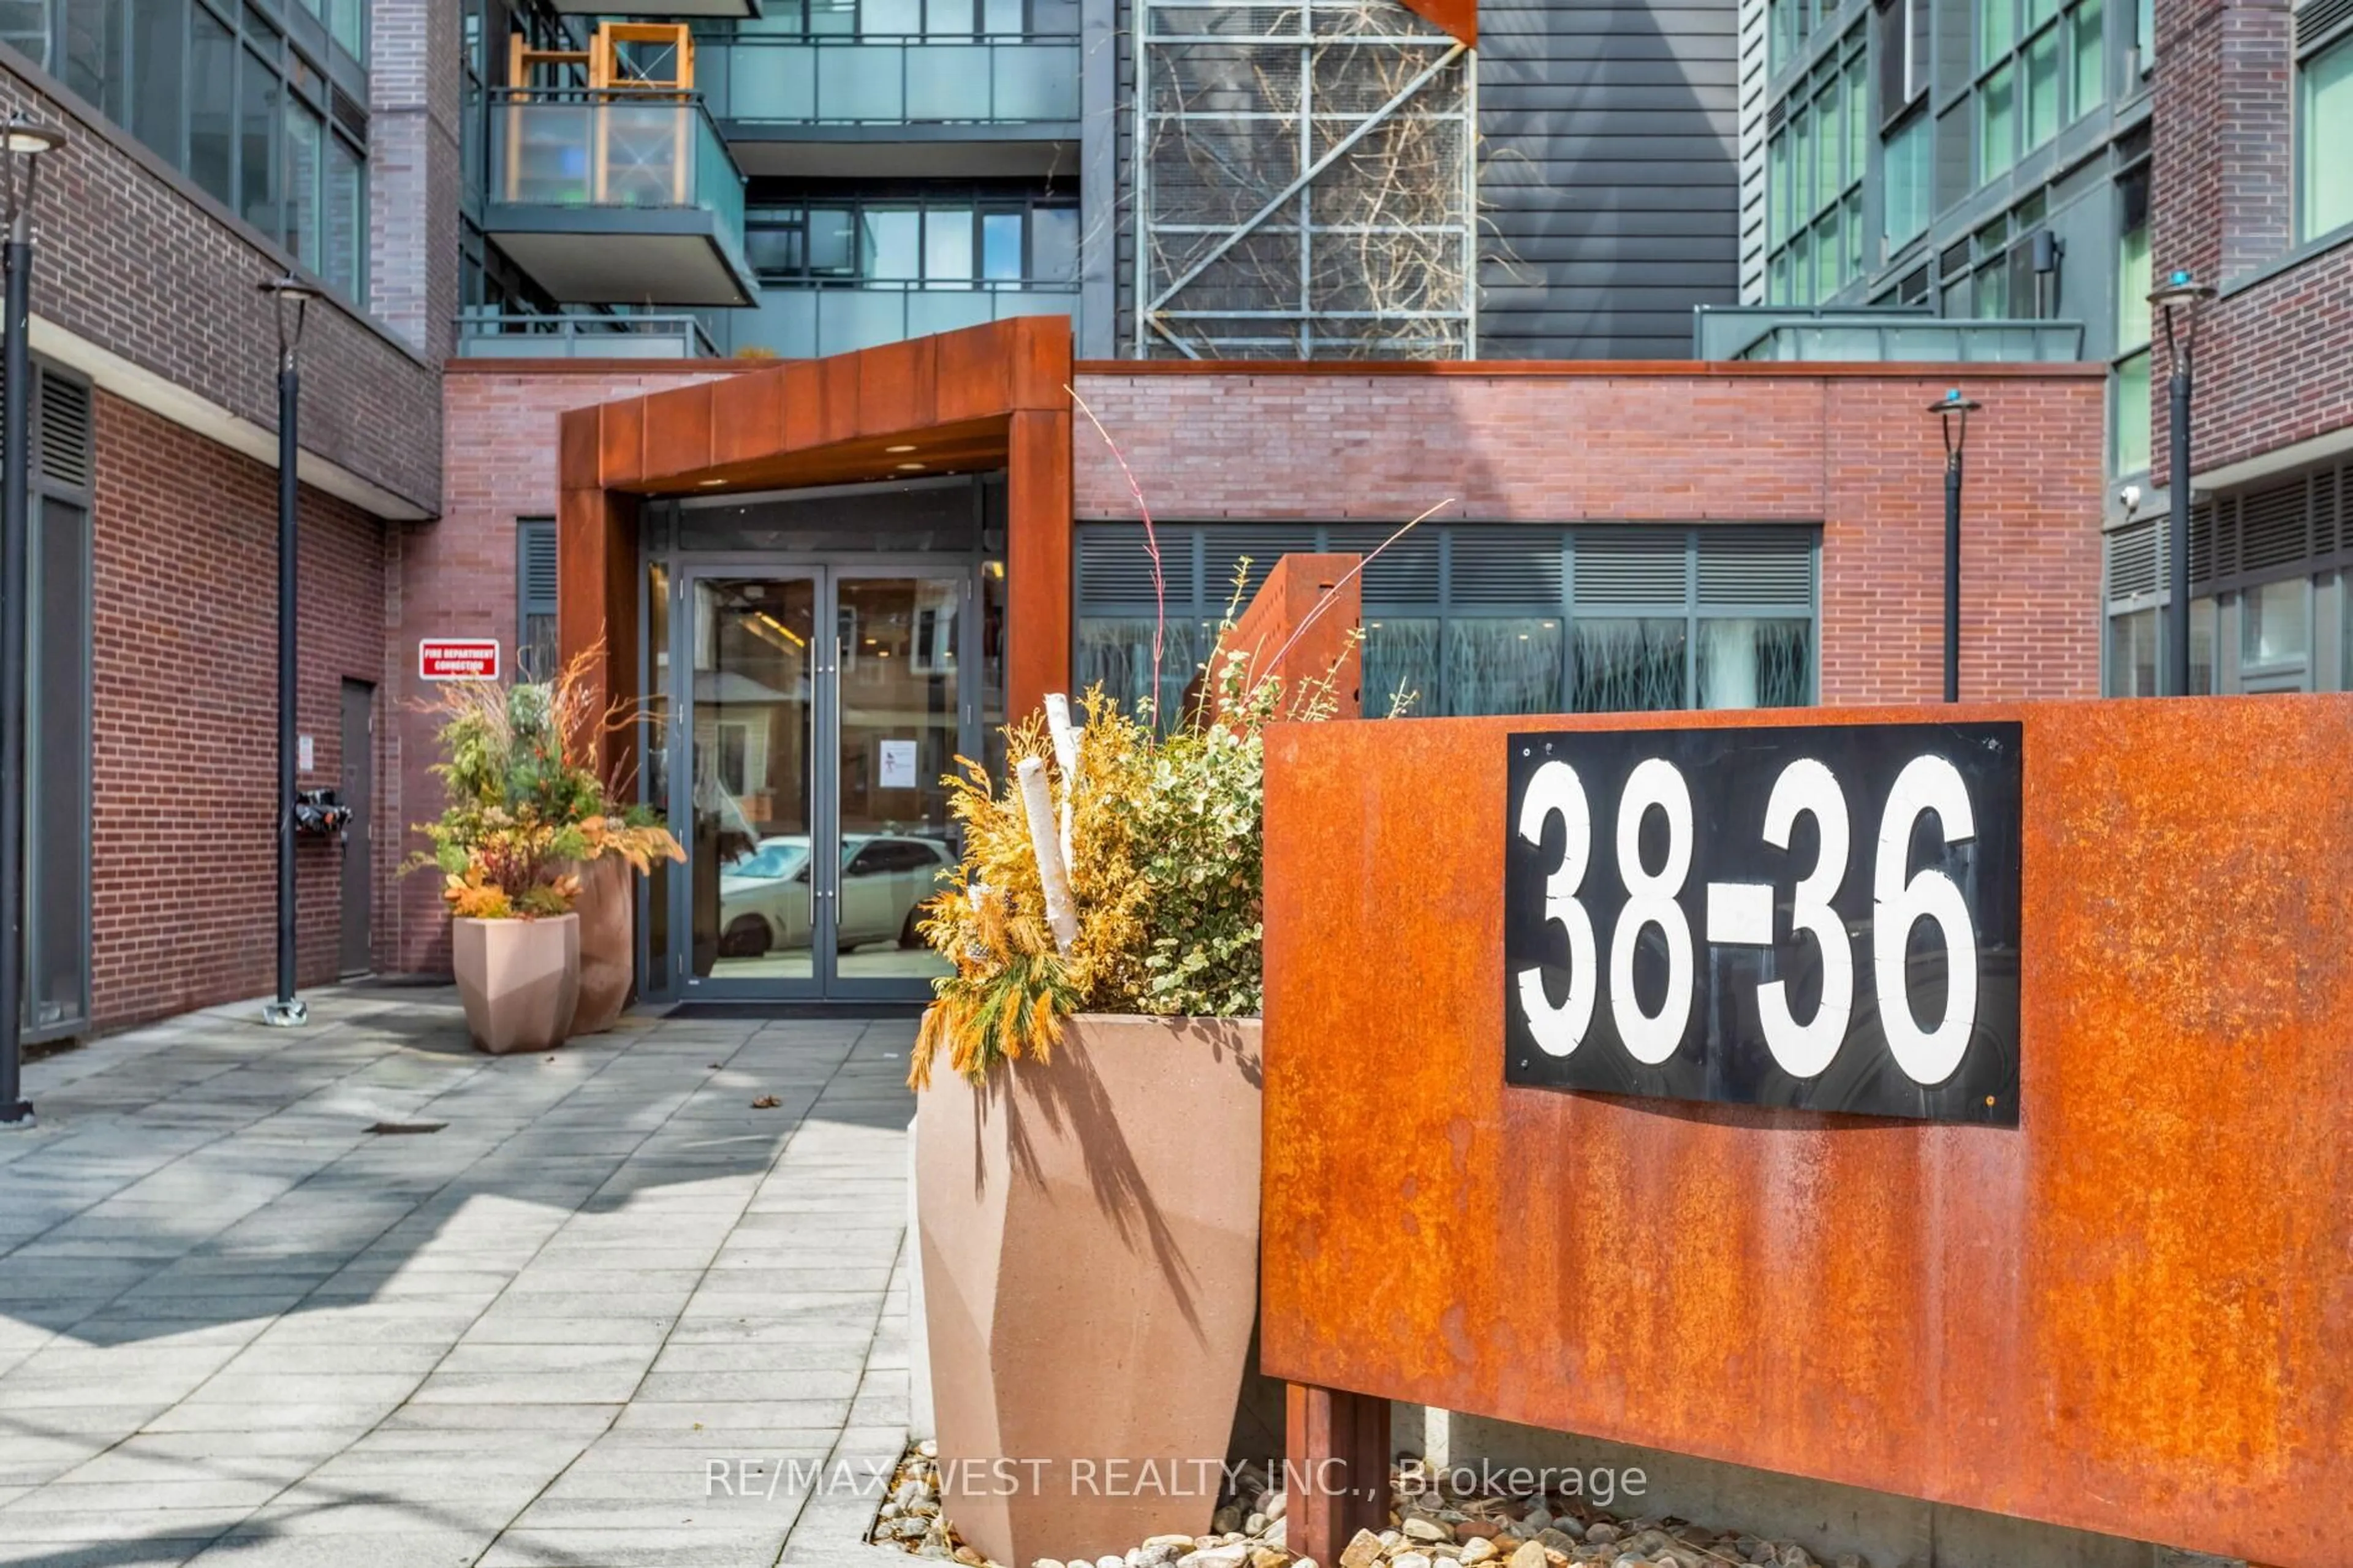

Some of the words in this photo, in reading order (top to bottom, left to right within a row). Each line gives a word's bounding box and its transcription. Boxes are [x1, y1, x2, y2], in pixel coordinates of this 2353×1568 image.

[425, 648, 442, 659] FIRE
[444, 648, 493, 659] DEPARTMENT
[1517, 754, 1977, 1085] 38-36
